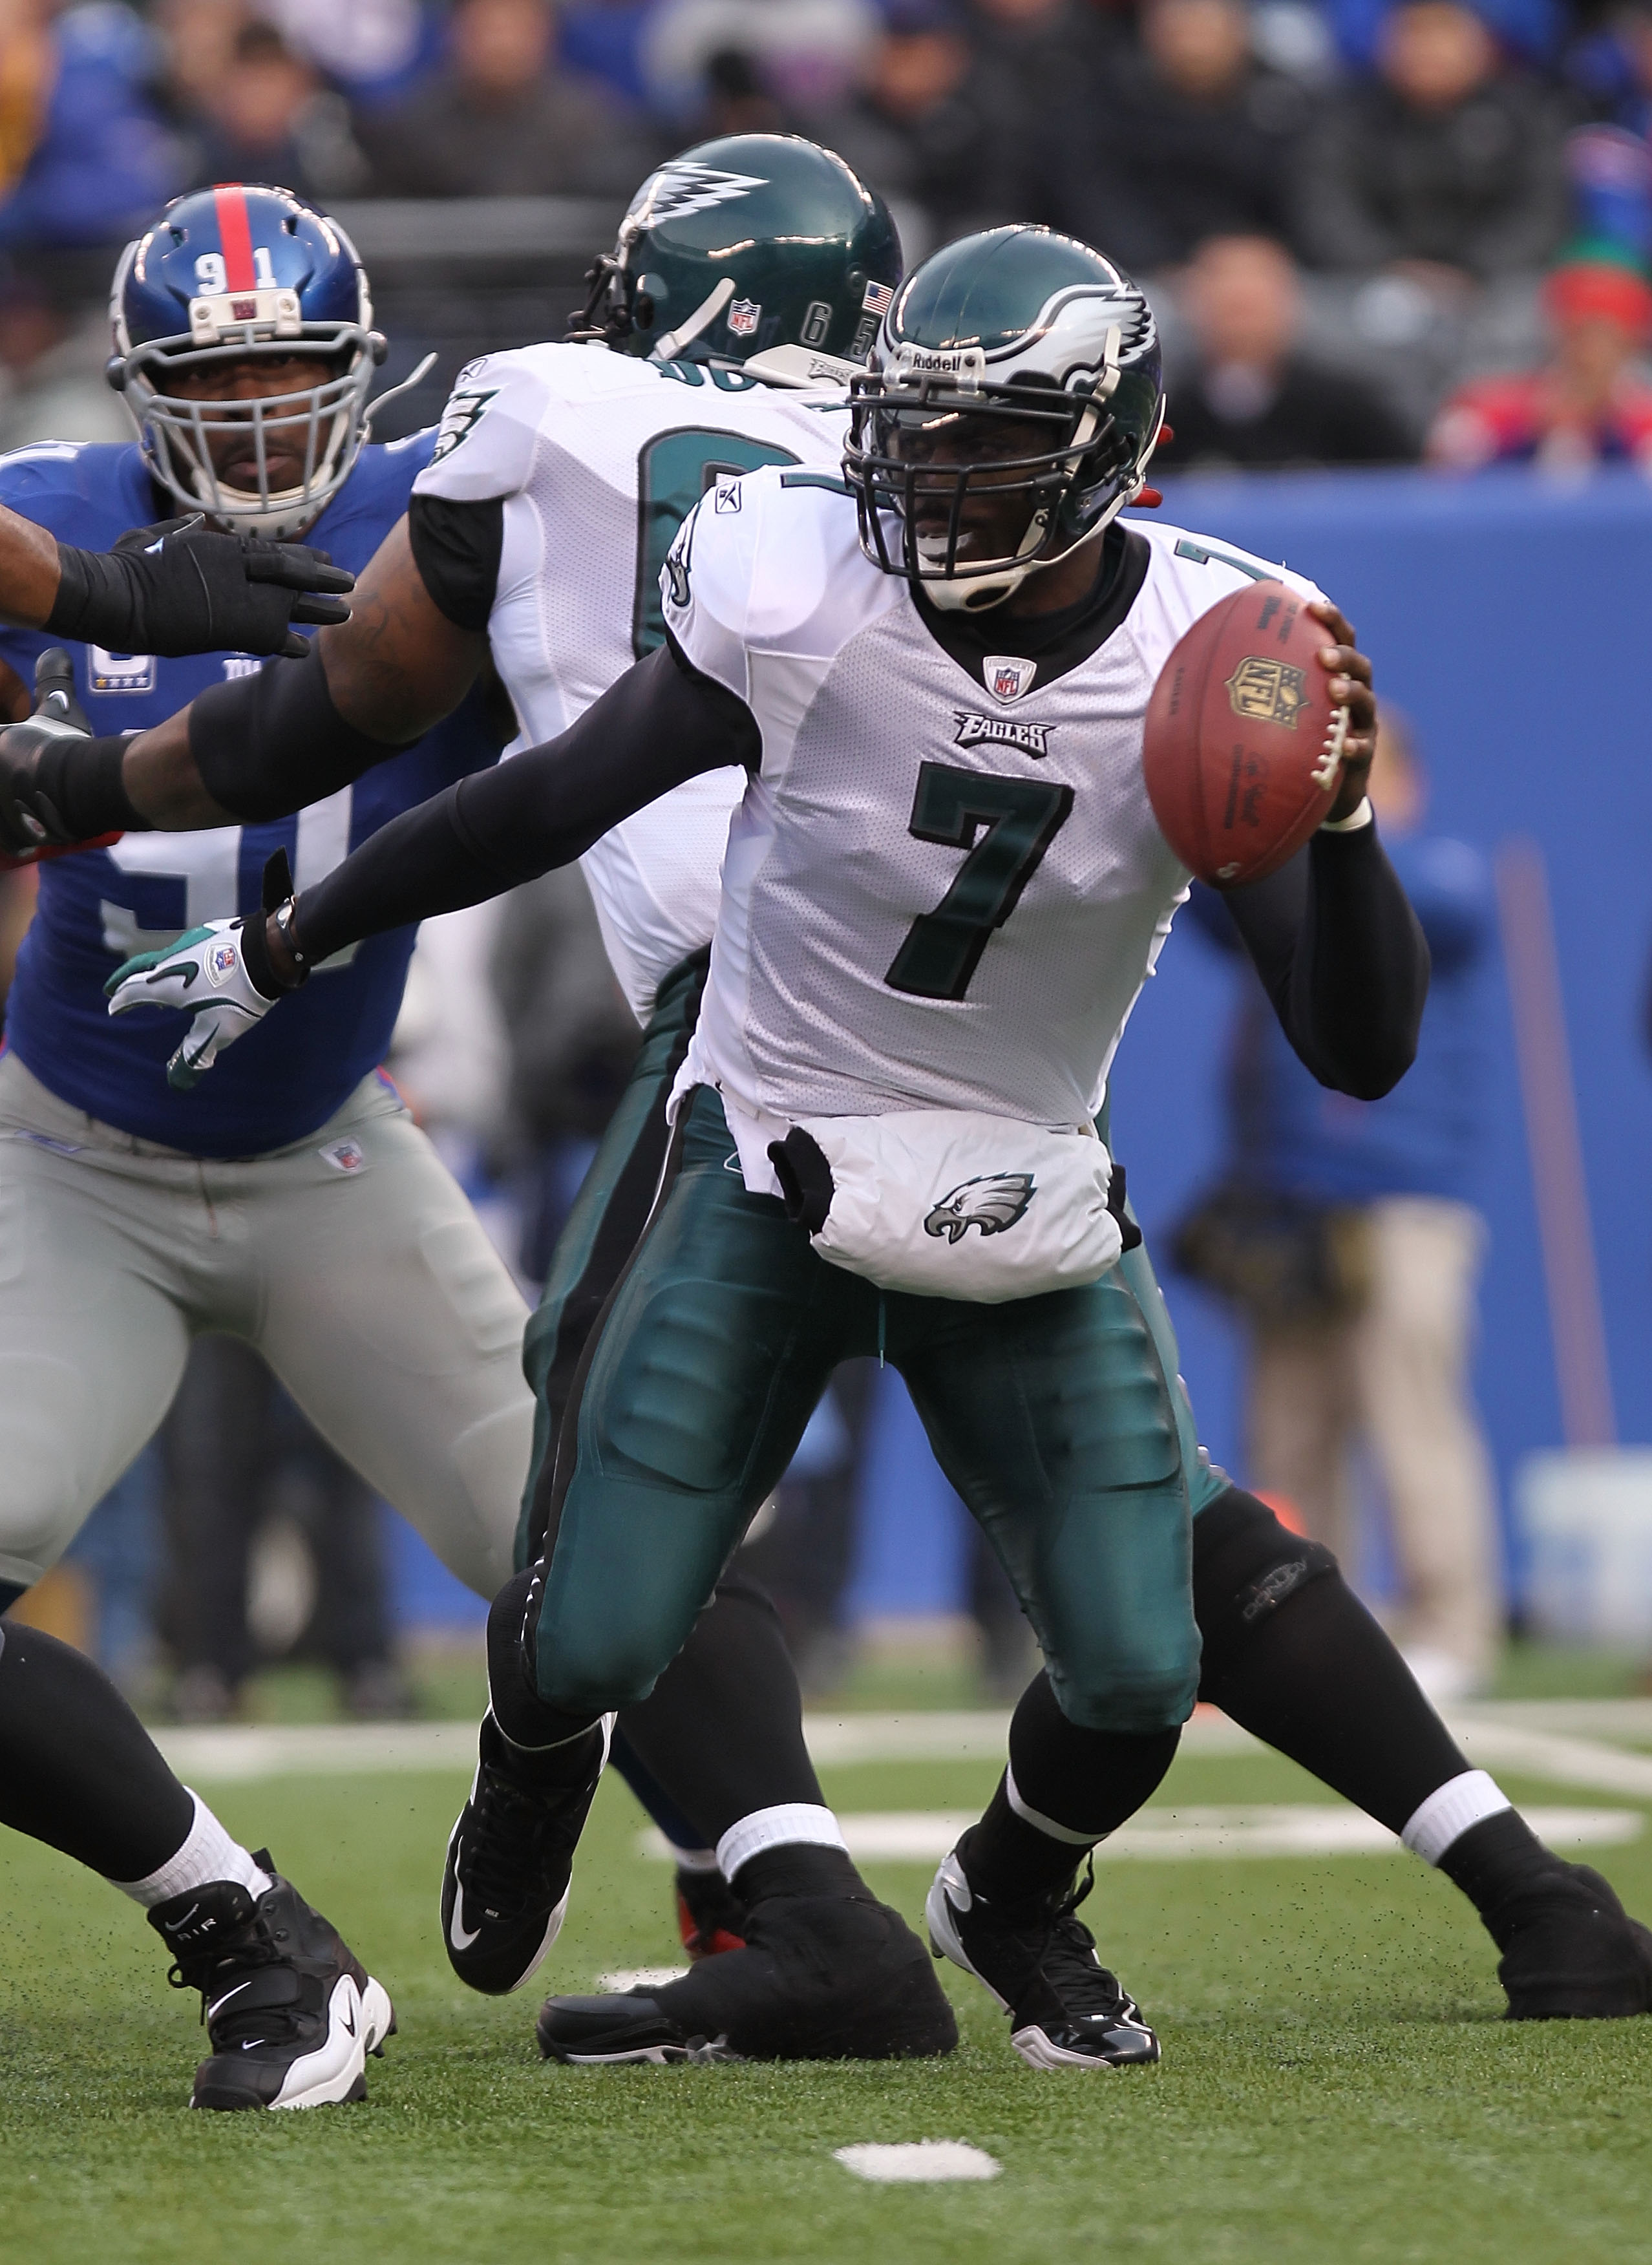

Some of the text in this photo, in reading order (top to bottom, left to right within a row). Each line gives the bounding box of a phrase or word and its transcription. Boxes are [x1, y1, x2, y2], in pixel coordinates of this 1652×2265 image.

[195, 246, 277, 295] 91
[732, 314, 755, 329] NFL
[801, 301, 832, 345] 6
[913, 353, 961, 371] Riddell
[995, 678, 1018, 694] NFL
[1236, 661, 1282, 717] NFL
[953, 712, 1057, 760] EAGLES
[884, 761, 1075, 1001] 7
[177, 1918, 217, 1941] AIR
